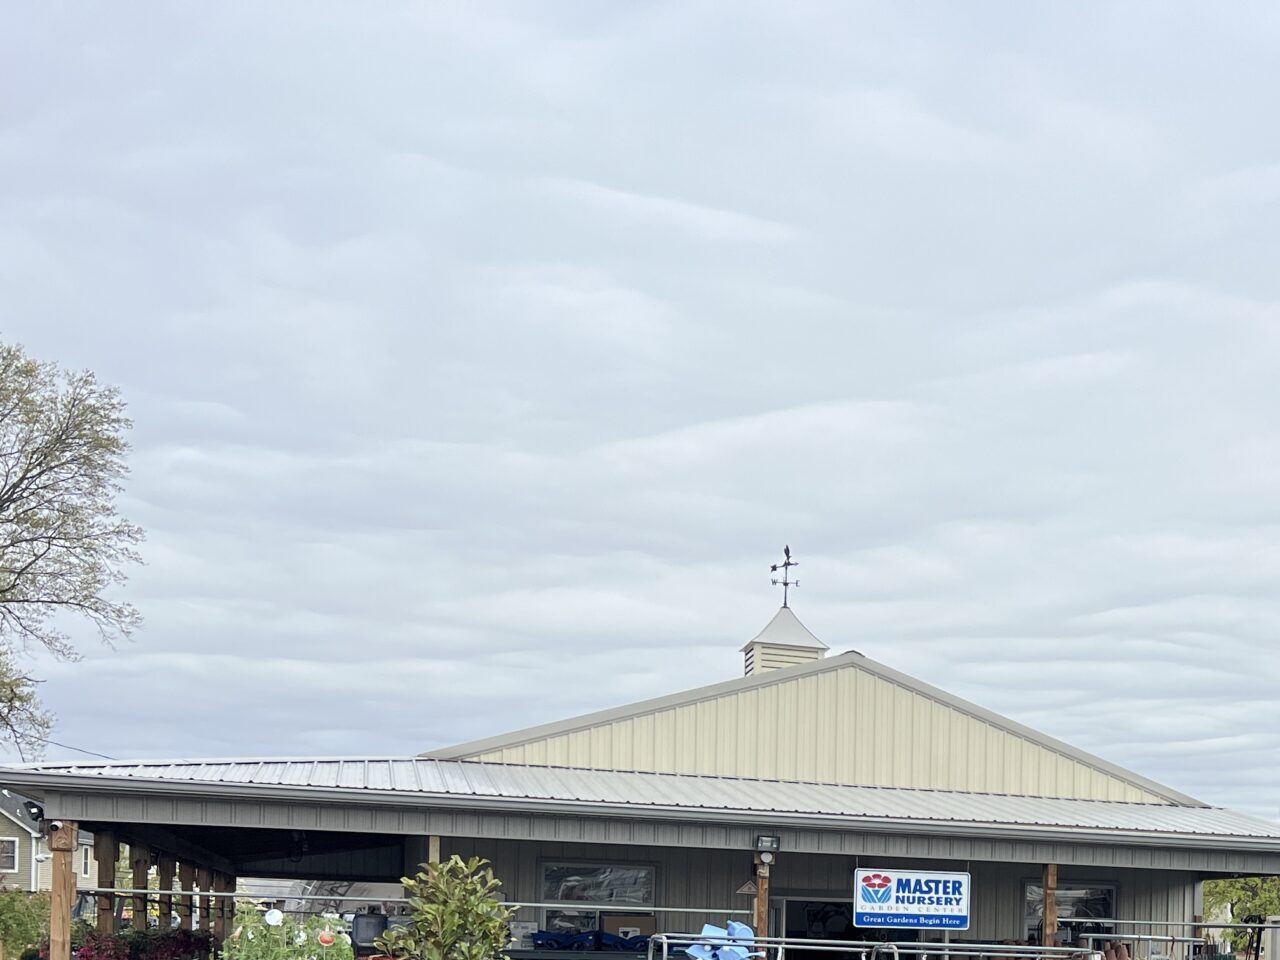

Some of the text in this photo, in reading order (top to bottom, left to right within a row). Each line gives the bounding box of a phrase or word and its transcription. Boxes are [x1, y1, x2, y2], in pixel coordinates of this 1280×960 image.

[895, 878, 963, 896] MASTER
[895, 895, 963, 906] NURSERY
[861, 904, 963, 914] GARDEN CENTER
[863, 914, 960, 925] Great Gardens Begin Here
